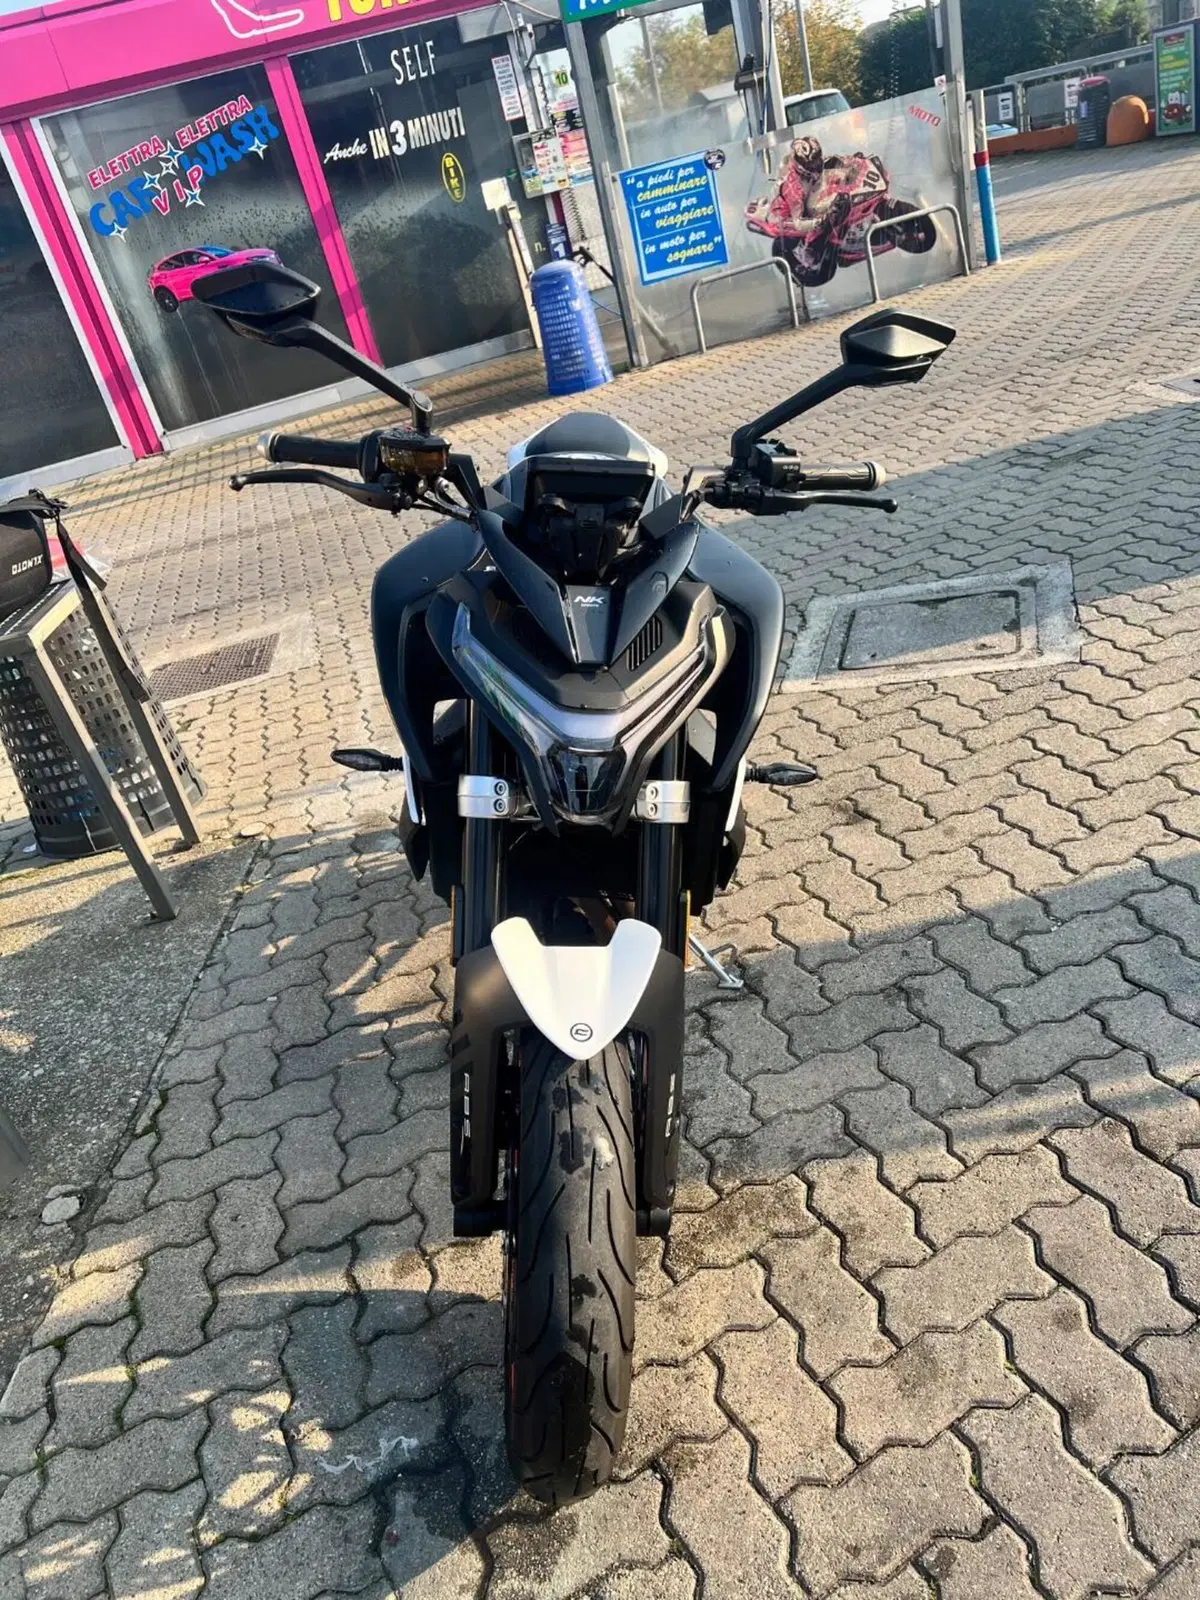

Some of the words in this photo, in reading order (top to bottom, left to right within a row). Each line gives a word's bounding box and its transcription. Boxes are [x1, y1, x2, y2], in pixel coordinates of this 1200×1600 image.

[390, 40, 436, 85] SELF
[907, 105, 941, 126] MOTO
[87, 135, 166, 190] ELETTRA
[175, 94, 253, 149] ELETTRA
[323, 138, 368, 164] Anche
[368, 126, 391, 160] IN
[390, 120, 408, 155] 3
[407, 107, 466, 149] MINUTI
[88, 176, 159, 238] CAR
[179, 104, 280, 177] WASH
[444, 156, 462, 199] BIKE
[647, 169, 674, 189] piedi
[677, 166, 696, 183] per
[636, 175, 708, 202] camminare
[640, 208, 651, 219] in
[654, 201, 677, 215] auto
[680, 196, 697, 211] per
[655, 205, 714, 229] viaggiare
[644, 243, 656, 255] in
[660, 236, 686, 249] moto
[688, 230, 706, 245] per
[11, 554, 43, 576] XLMOTO
[573, 595, 605, 604] NK
